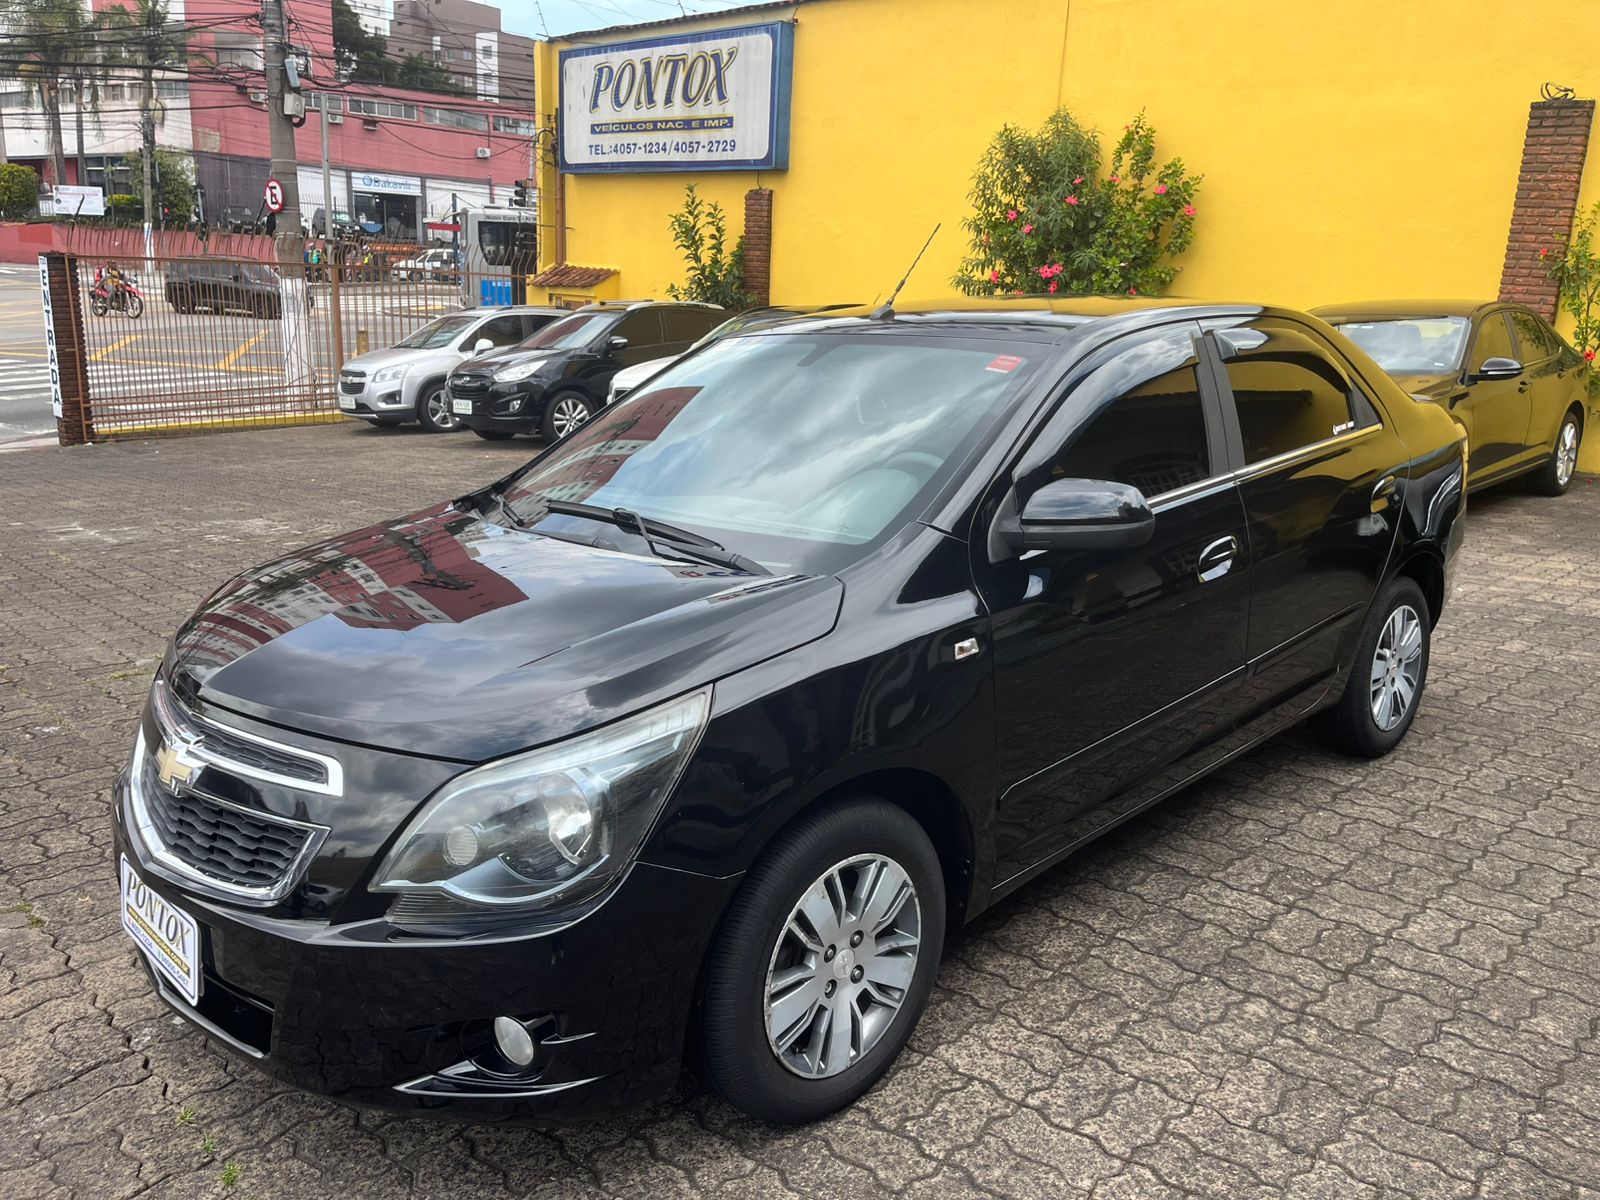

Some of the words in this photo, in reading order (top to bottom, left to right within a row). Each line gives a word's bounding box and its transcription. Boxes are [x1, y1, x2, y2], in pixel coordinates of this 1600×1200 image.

[590, 46, 739, 113] PONTOX
[657, 121, 688, 129] NAC.
[692, 120, 701, 128] E
[704, 118, 730, 127] IMP.
[41, 269, 61, 405] ENTRADA
[126, 870, 191, 959] PONTOX
